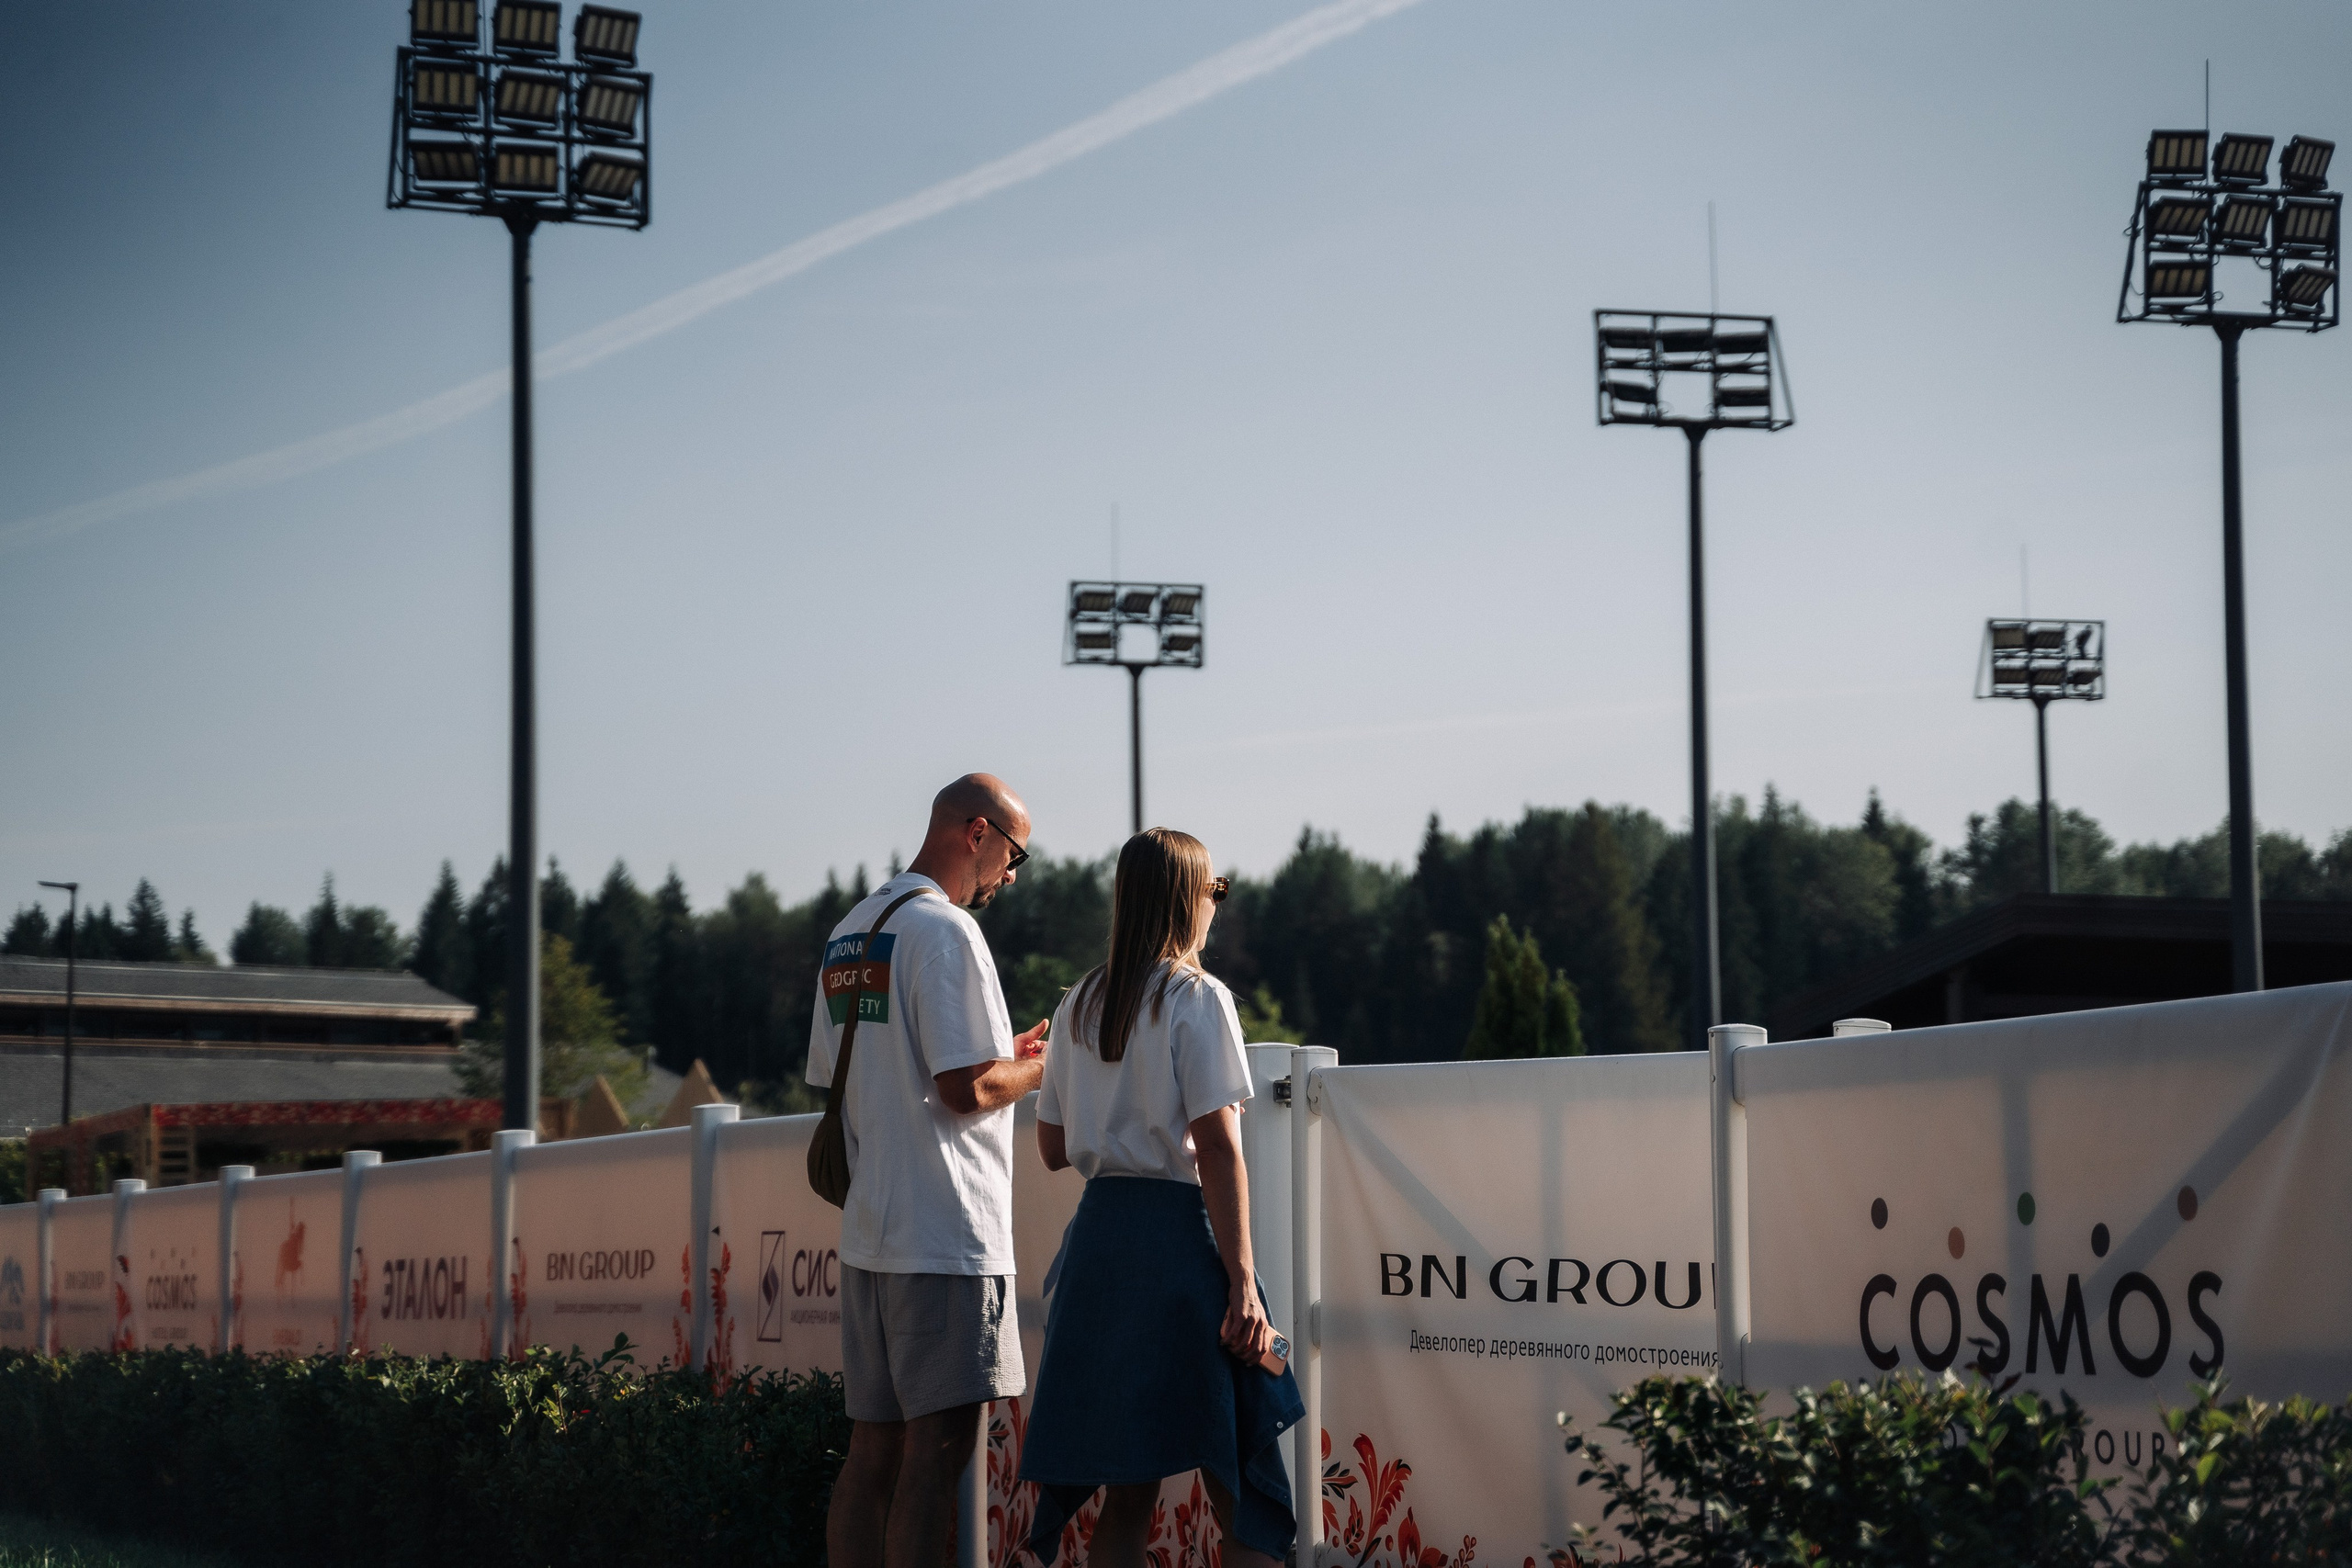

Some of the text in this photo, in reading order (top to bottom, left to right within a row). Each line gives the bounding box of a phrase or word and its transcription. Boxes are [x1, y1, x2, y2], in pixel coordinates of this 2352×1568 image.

[828, 940, 865, 961] NATIONA
[858, 998, 880, 1014] ETY
[547, 1249, 655, 1280] BN GROUP
[792, 1248, 838, 1297] СИС
[1380, 1252, 1716, 1310] BN GROU
[380, 1256, 468, 1320] ЭТАЛОН
[1859, 1270, 2225, 1379] COSMOS
[1409, 1329, 1718, 1369] Девелопер деревянного домостроения
[2070, 1428, 2166, 1467] ROUP
